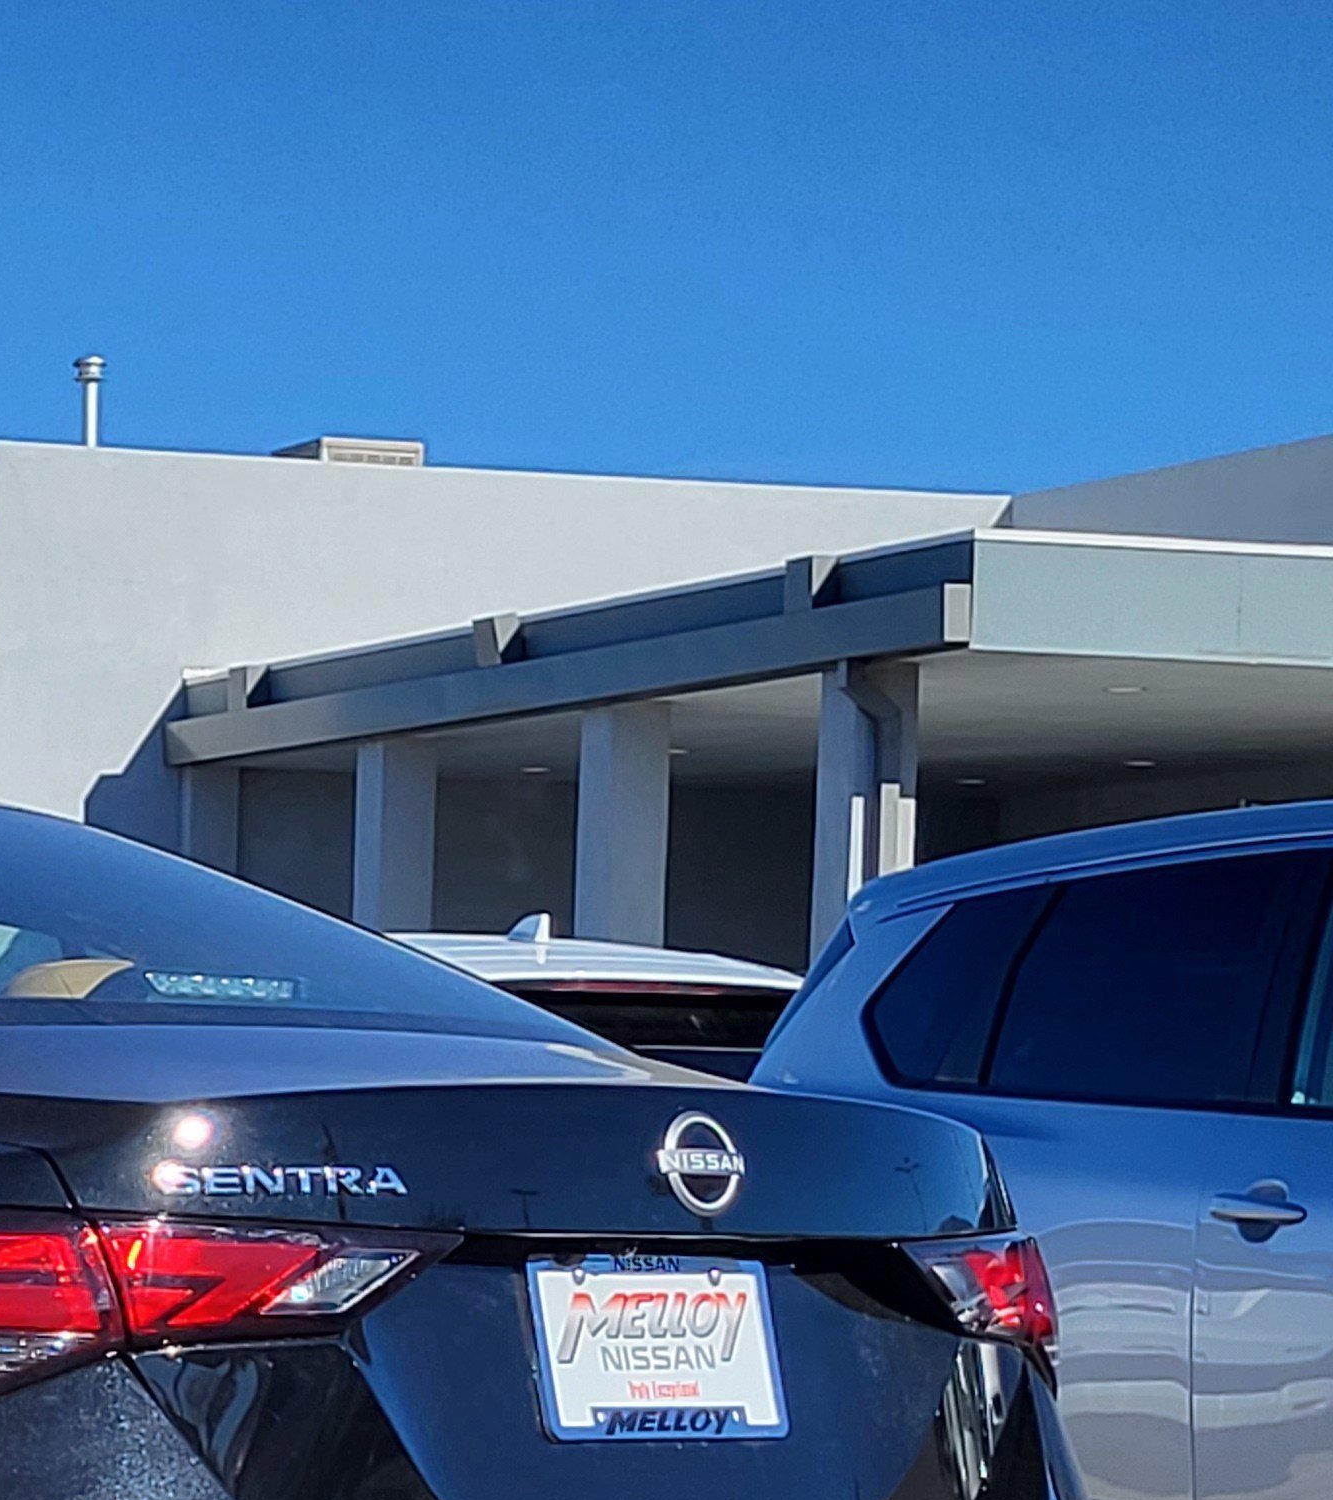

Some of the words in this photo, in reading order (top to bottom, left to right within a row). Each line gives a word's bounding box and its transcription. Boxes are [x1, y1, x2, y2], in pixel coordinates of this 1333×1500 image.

[657, 1149, 745, 1176] NISSAN
[153, 1164, 408, 1196] SENTRA
[613, 1256, 680, 1272] NISSAN
[556, 1291, 747, 1364] MELLOY
[600, 1345, 716, 1371] NISSAN
[605, 1408, 732, 1435] MELLOY
